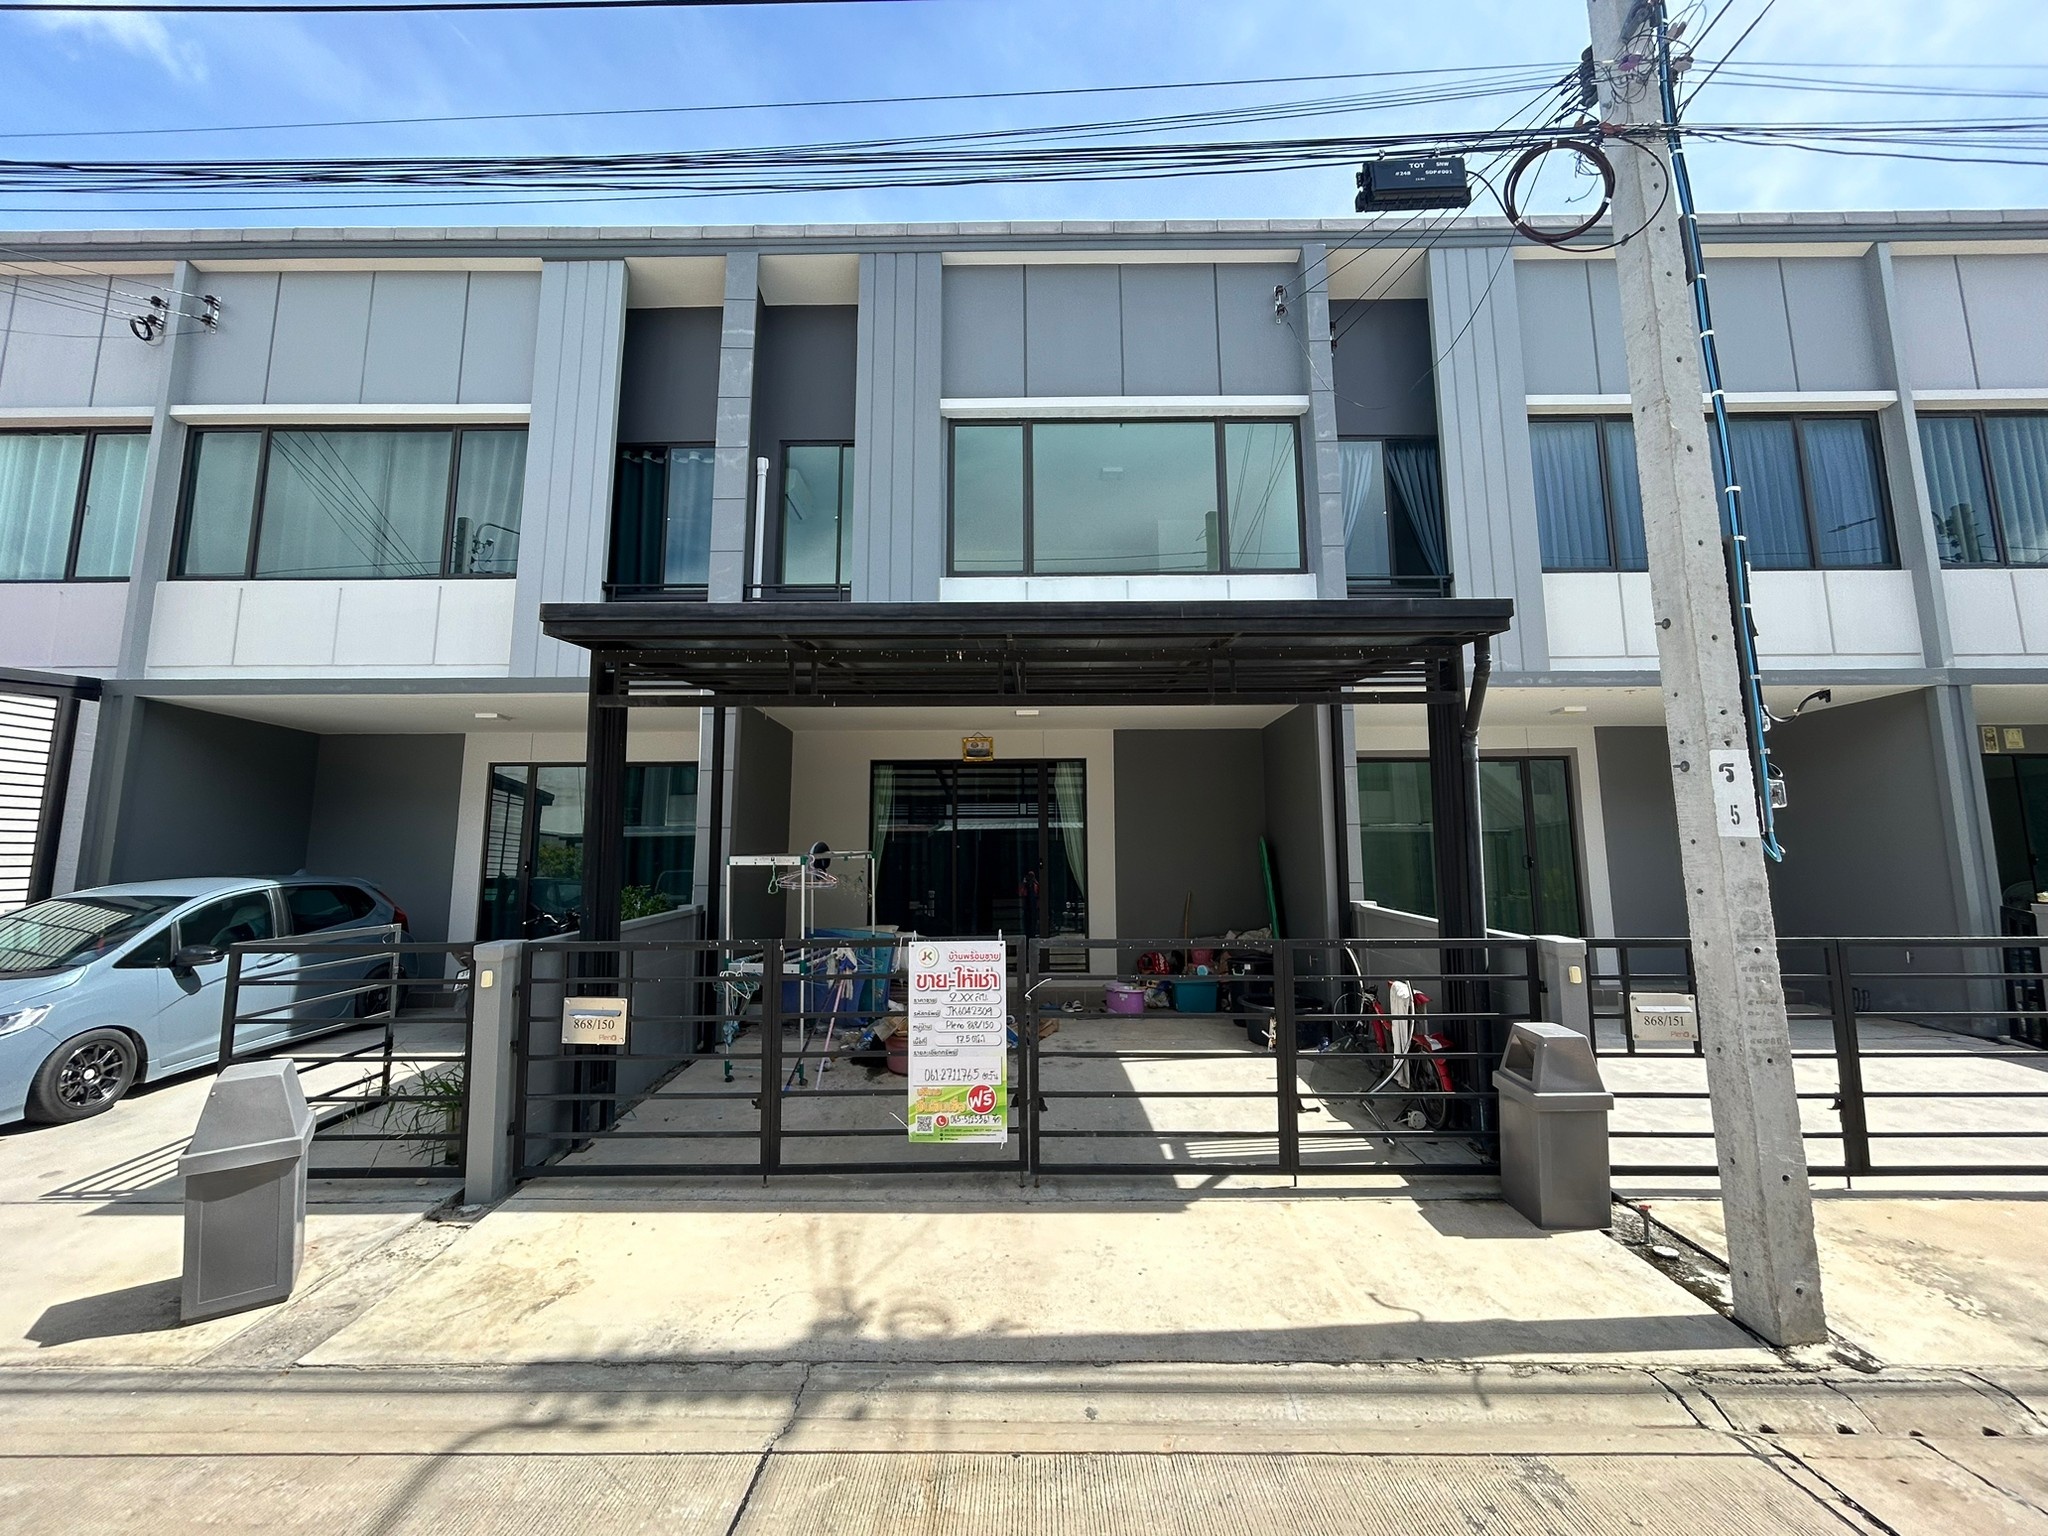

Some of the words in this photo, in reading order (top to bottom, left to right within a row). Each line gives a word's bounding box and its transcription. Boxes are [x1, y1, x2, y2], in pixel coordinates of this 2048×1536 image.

[1730, 804, 1741, 825] 5
[921, 951, 933, 961] JK
[948, 951, 1001, 961] บ้านพร้อมขาย
[916, 966, 998, 989] ขาย-ให้เช่า
[573, 1019, 615, 1030] 868/150
[1643, 1015, 1685, 1026] 868/151
[969, 1088, 993, 1108] ฟรี
